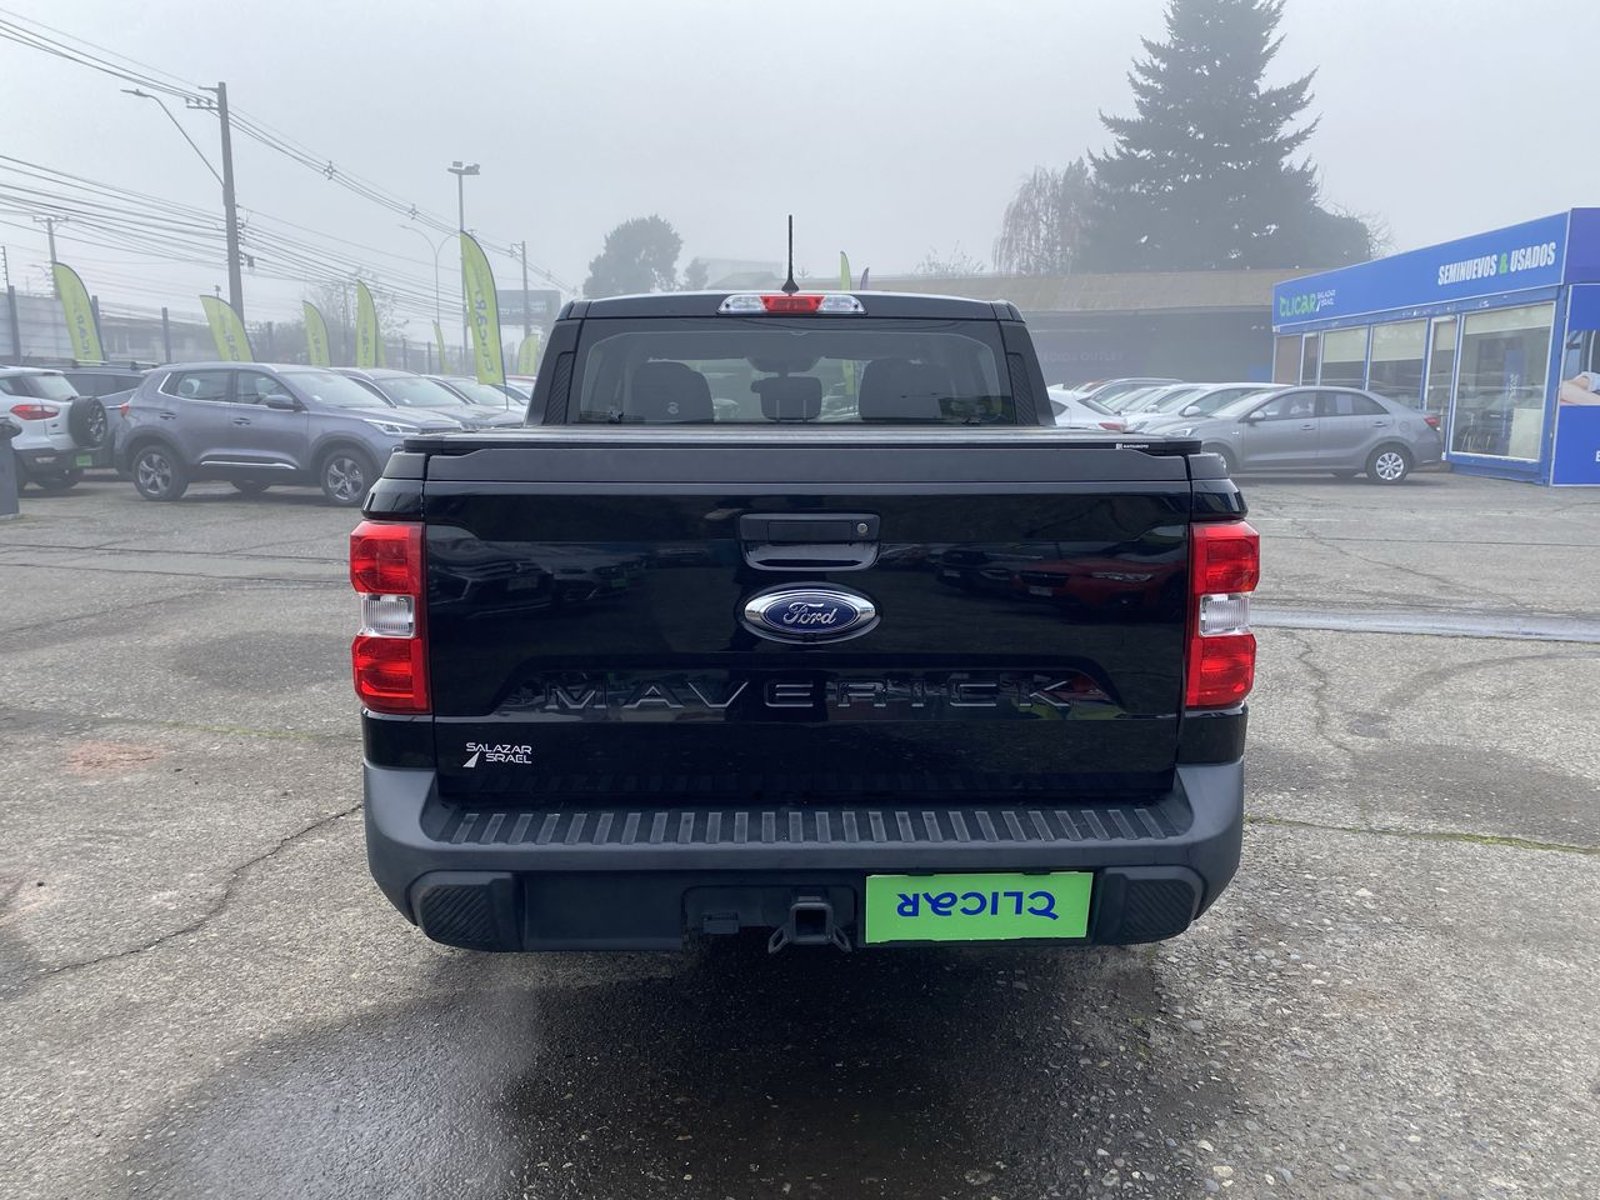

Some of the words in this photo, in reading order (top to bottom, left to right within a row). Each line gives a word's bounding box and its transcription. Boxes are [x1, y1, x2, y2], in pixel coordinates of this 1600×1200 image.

[1437, 254, 1498, 285] SEMINUEVOS
[1499, 252, 1508, 274] &
[1509, 241, 1557, 272] USADOS
[783, 601, 838, 625] Ford
[544, 678, 1070, 710] MAVERICK
[465, 742, 532, 754] SALAZAR
